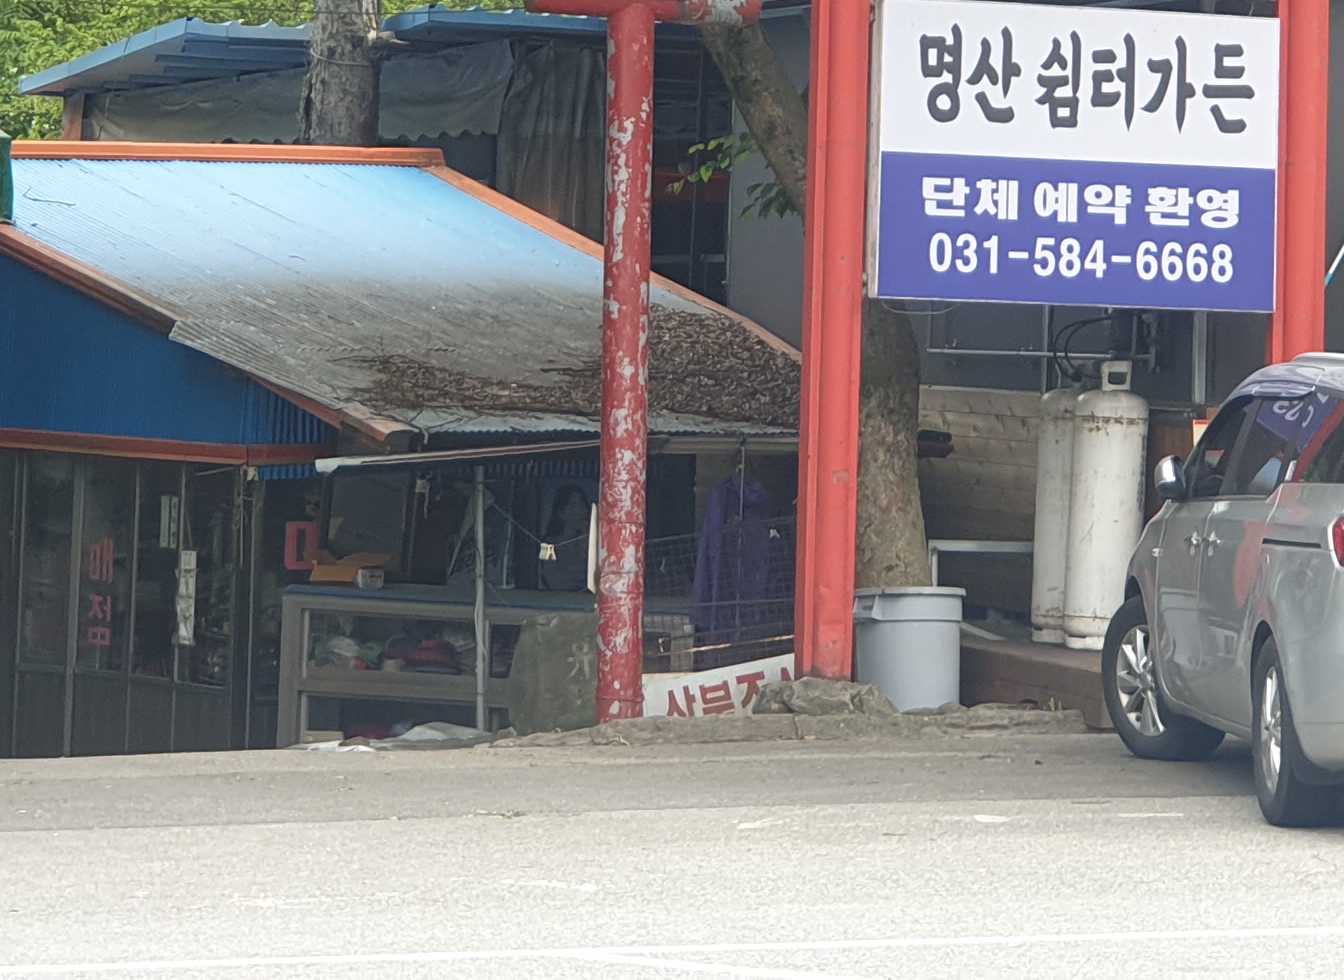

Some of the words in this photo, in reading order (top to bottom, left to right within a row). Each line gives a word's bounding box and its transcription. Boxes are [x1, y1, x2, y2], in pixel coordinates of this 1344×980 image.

[920, 24, 1022, 124] 명산
[1035, 30, 1255, 134] 쉼터가든
[922, 176, 1018, 219] 단체
[1034, 181, 1131, 226] 예약
[1145, 185, 1240, 229] 환영
[929, 232, 1234, 283] 031-584-6668
